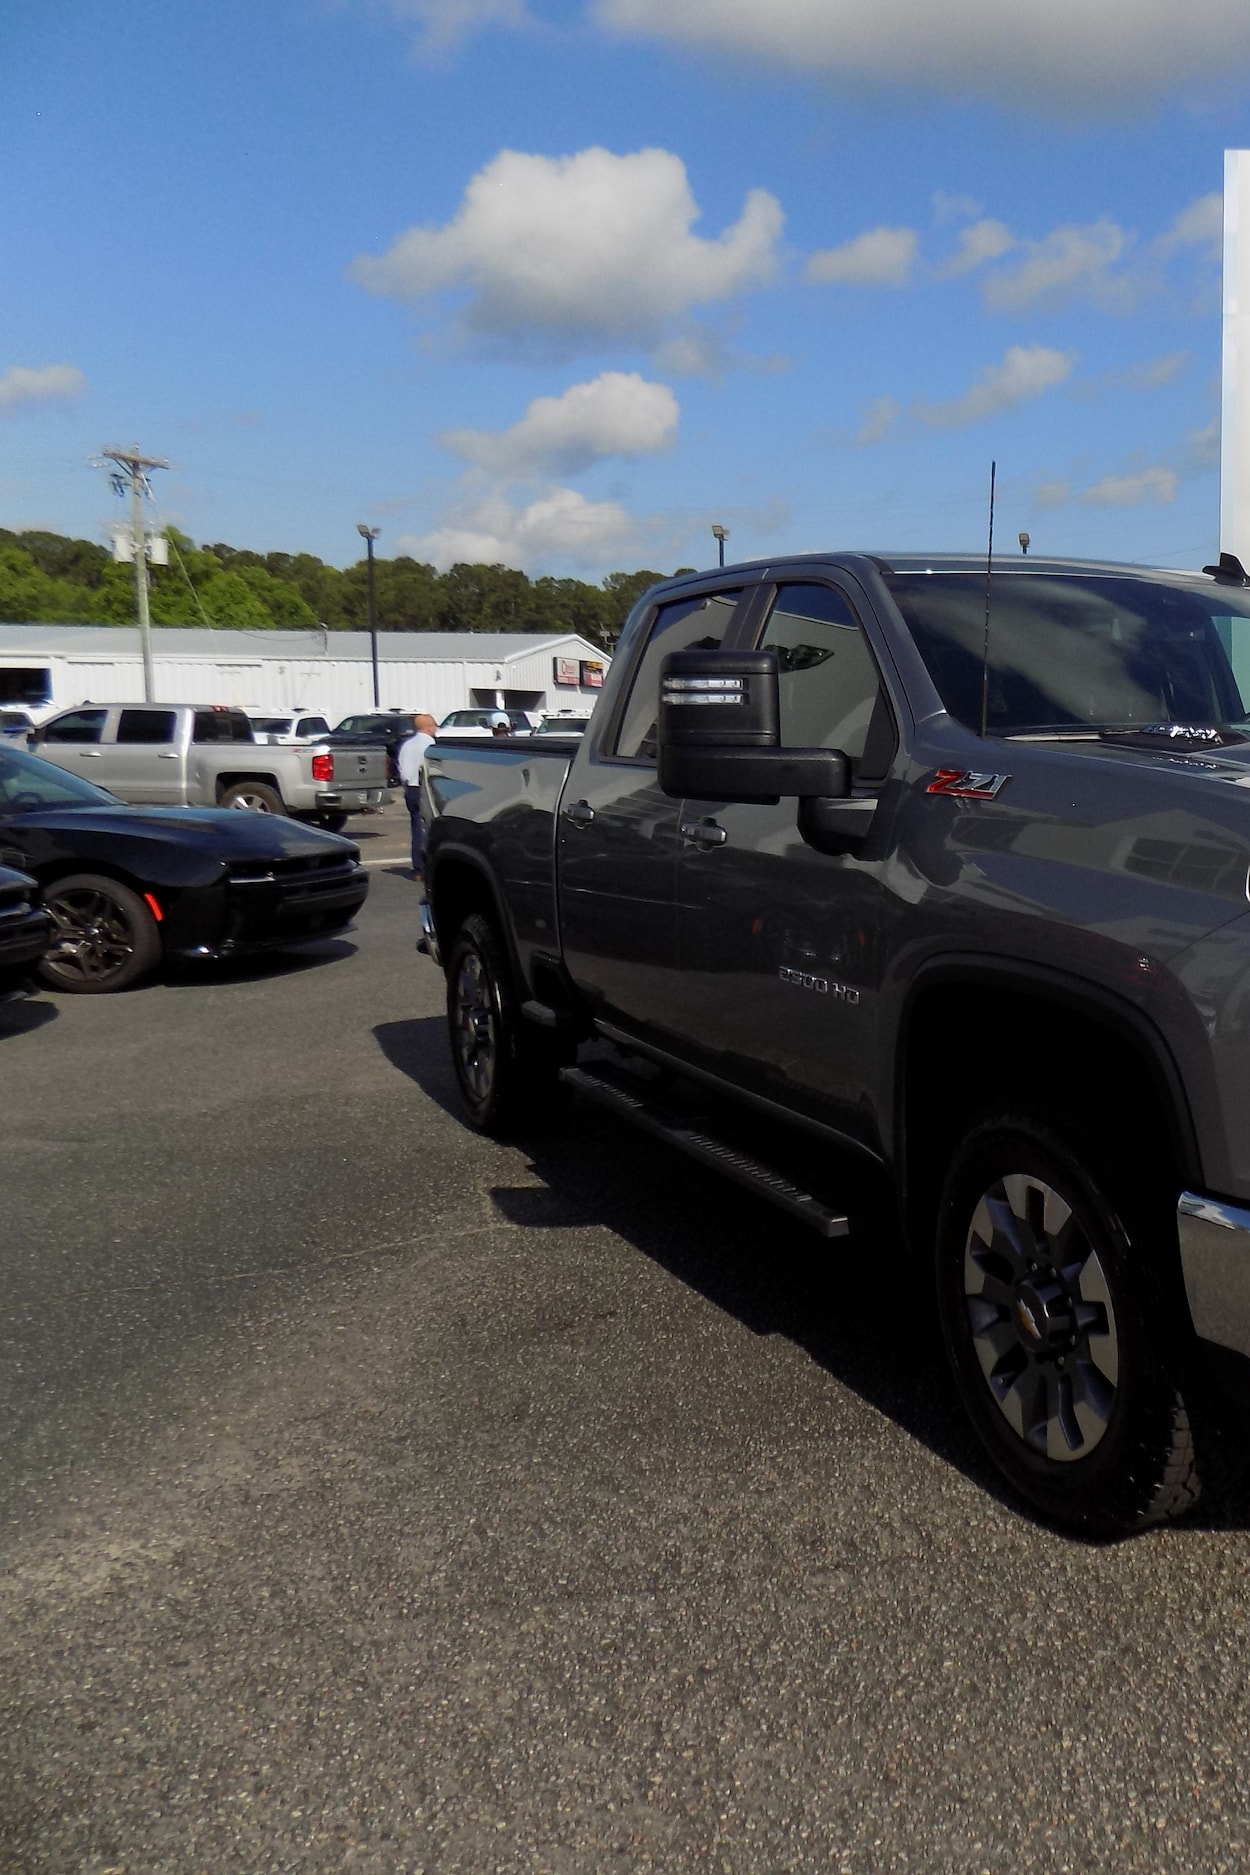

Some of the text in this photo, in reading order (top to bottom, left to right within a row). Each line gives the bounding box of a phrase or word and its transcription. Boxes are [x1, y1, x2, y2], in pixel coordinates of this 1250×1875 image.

[925, 769, 1013, 800] Z71
[779, 966, 860, 1005] 2500 HD
